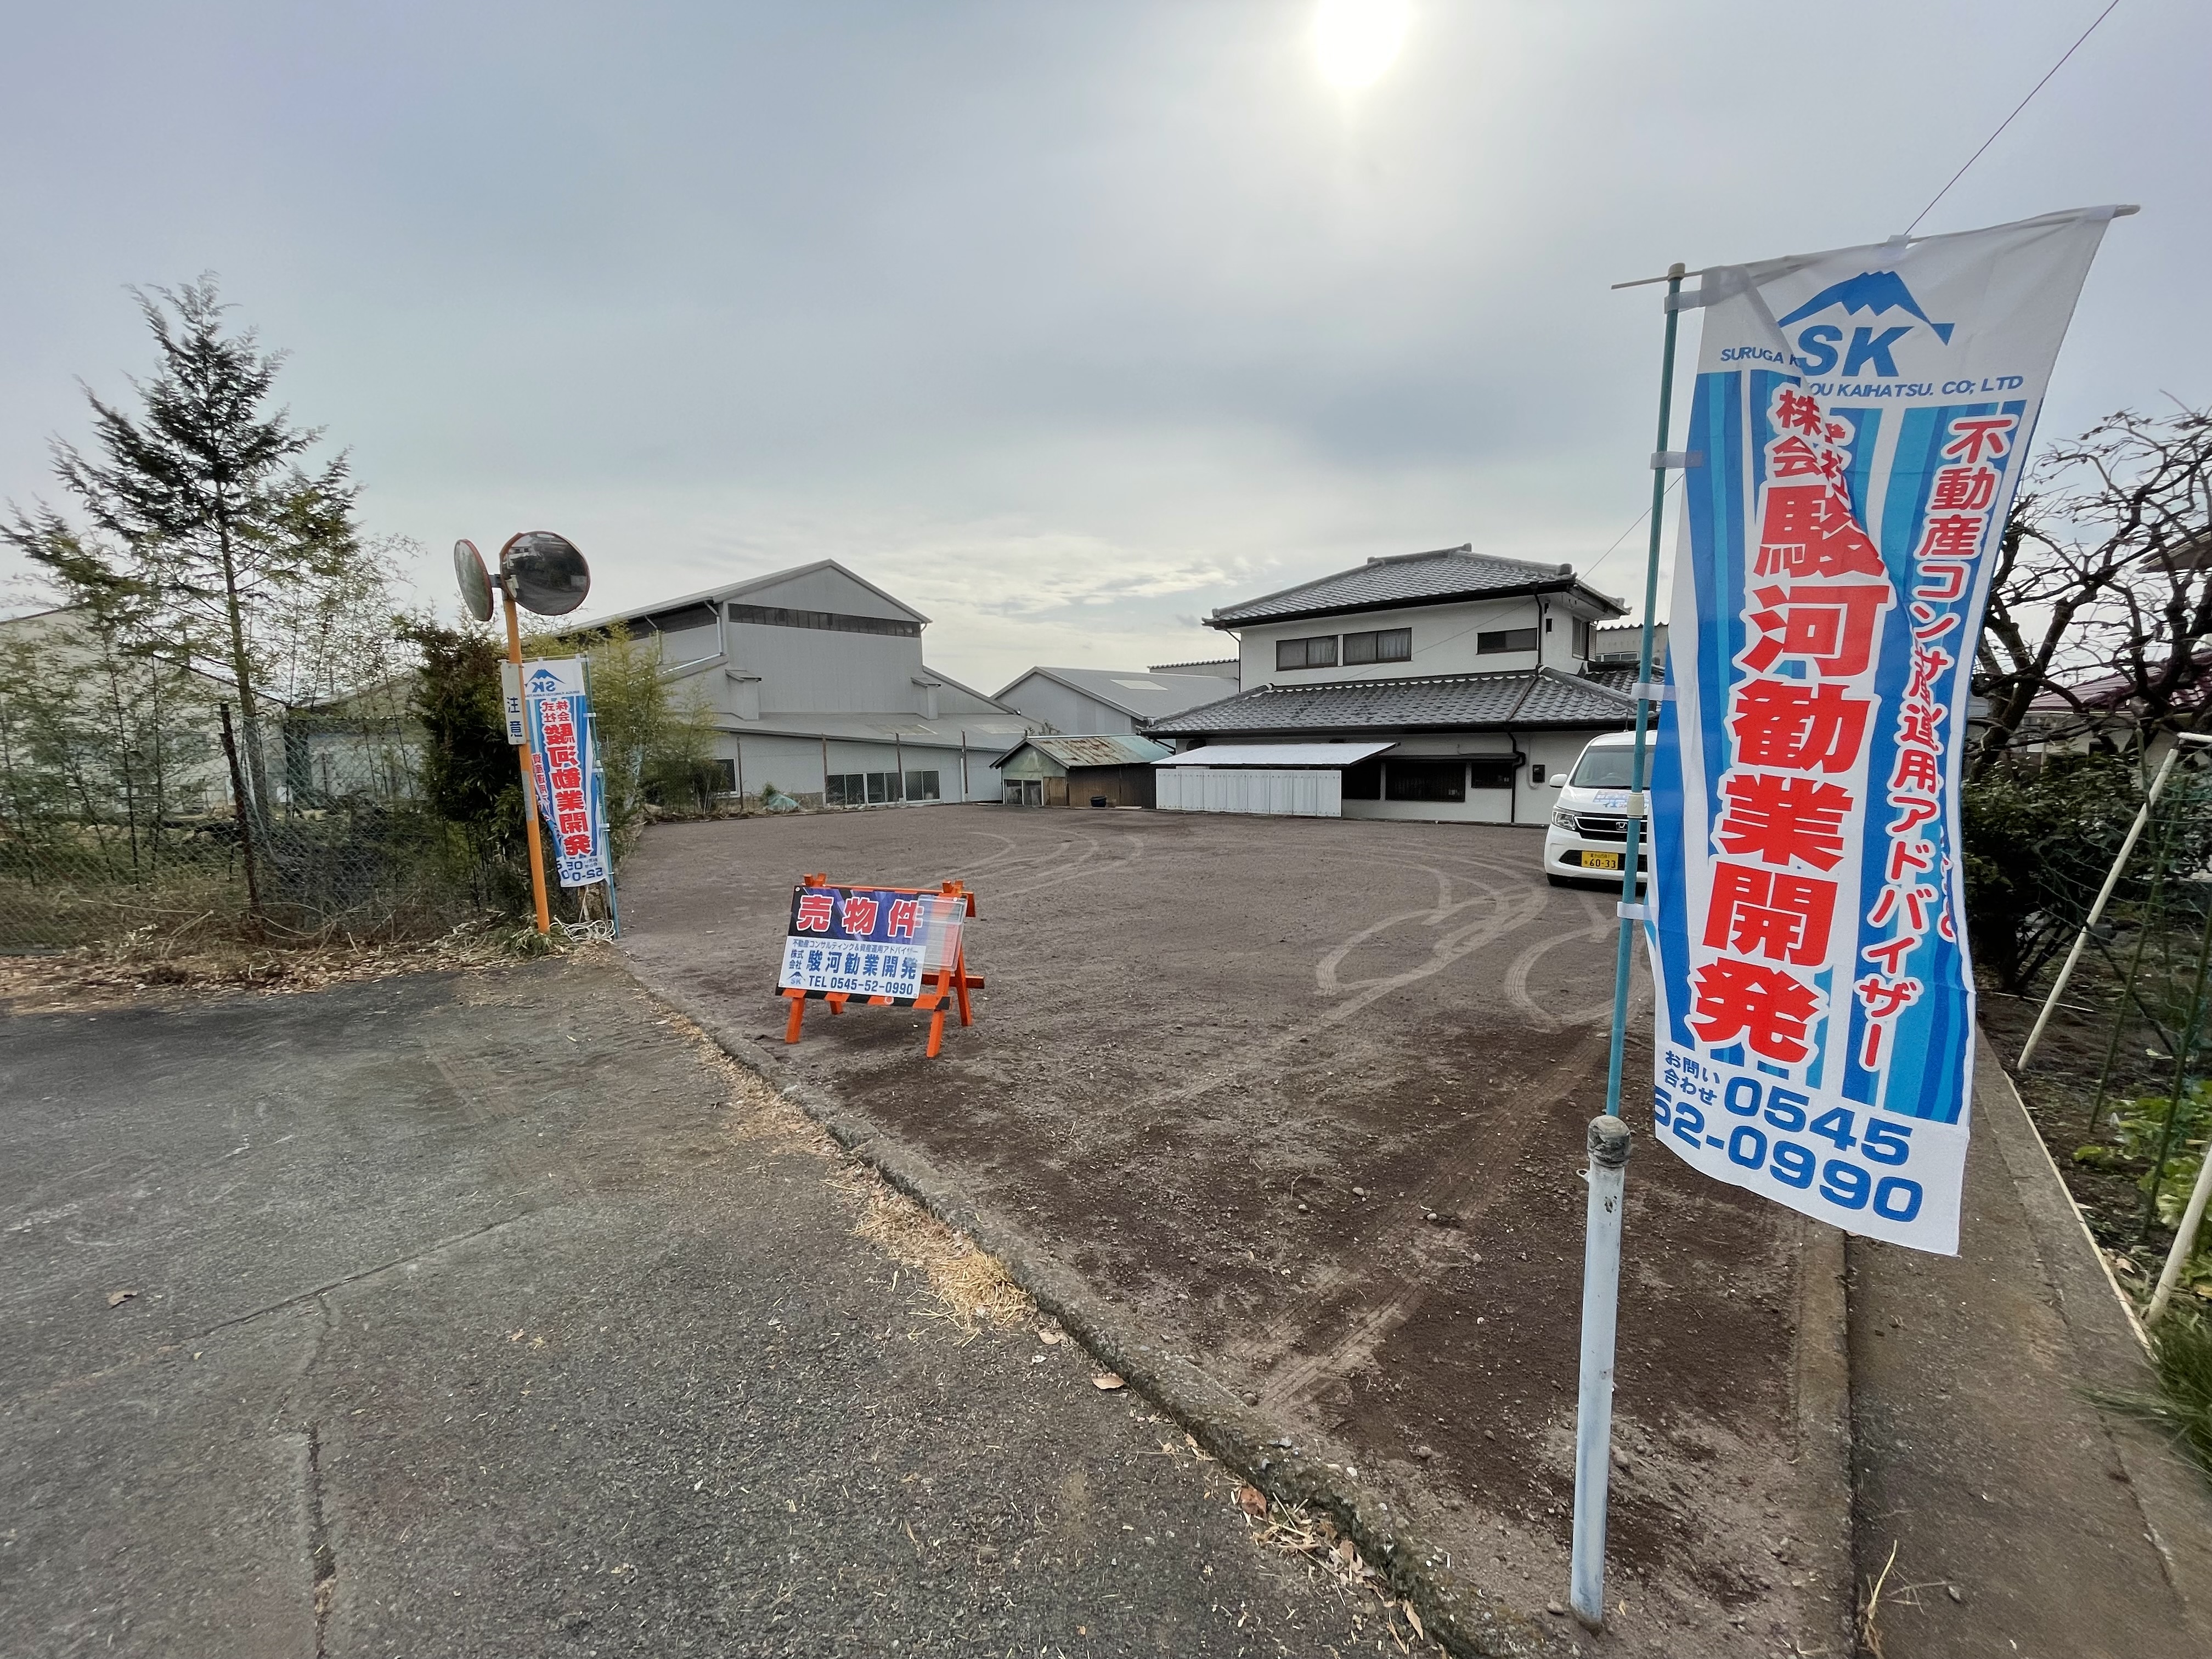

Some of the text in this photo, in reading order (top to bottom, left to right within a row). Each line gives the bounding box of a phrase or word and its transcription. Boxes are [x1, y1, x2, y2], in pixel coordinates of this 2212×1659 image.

[1798, 324, 1915, 377] SK
[1720, 347, 1784, 365] SURUGA
[1981, 375, 2024, 392] LTD
[506, 697, 523, 738] 注意
[1589, 859, 1616, 868] 60-33
[795, 895, 924, 938] 売物件
[788, 960, 802, 970] 会社
[791, 949, 805, 960] 株式
[808, 950, 918, 980] 駿河勧業開発
[809, 975, 913, 995] TEL 0545-52-0990
[1665, 1050, 1720, 1084] お問い
[1664, 1069, 1717, 1106] 合わせ
[1724, 1076, 1913, 1166] 0545
[1654, 1084, 1923, 1222] 52-0990
